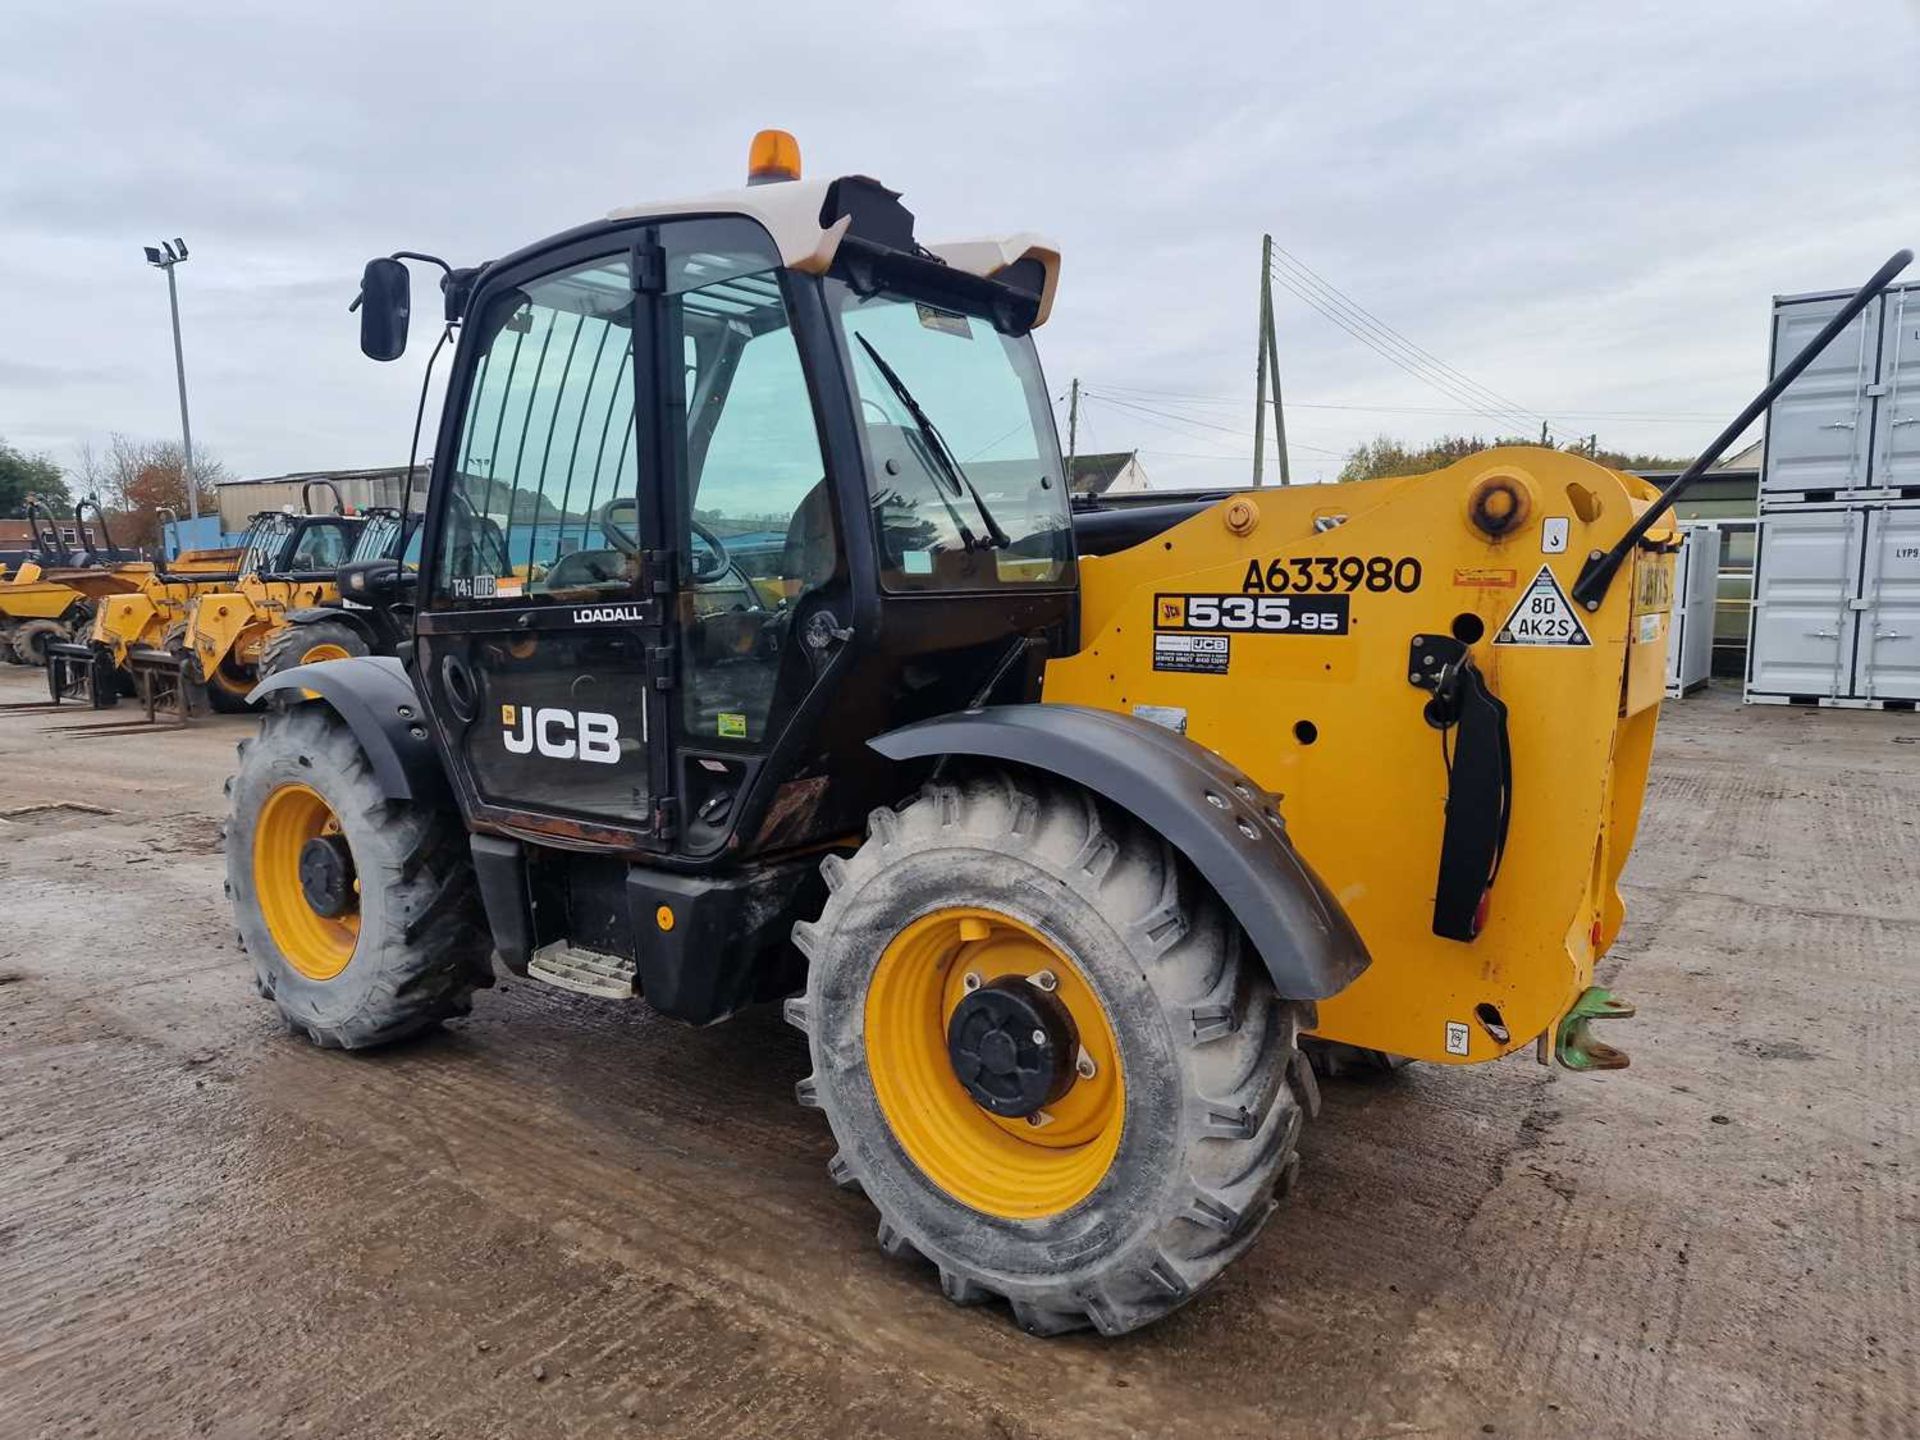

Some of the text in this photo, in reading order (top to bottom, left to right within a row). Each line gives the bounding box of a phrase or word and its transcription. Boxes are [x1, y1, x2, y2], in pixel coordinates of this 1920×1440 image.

[1242, 556, 1422, 593] A633980
[573, 607, 643, 623] LOADALL
[1187, 597, 1339, 630] 535-95
[1531, 597, 1556, 615] 80
[1518, 618, 1570, 637] AK2S
[1193, 639, 1225, 651] JCB
[503, 706, 621, 764] JCB
